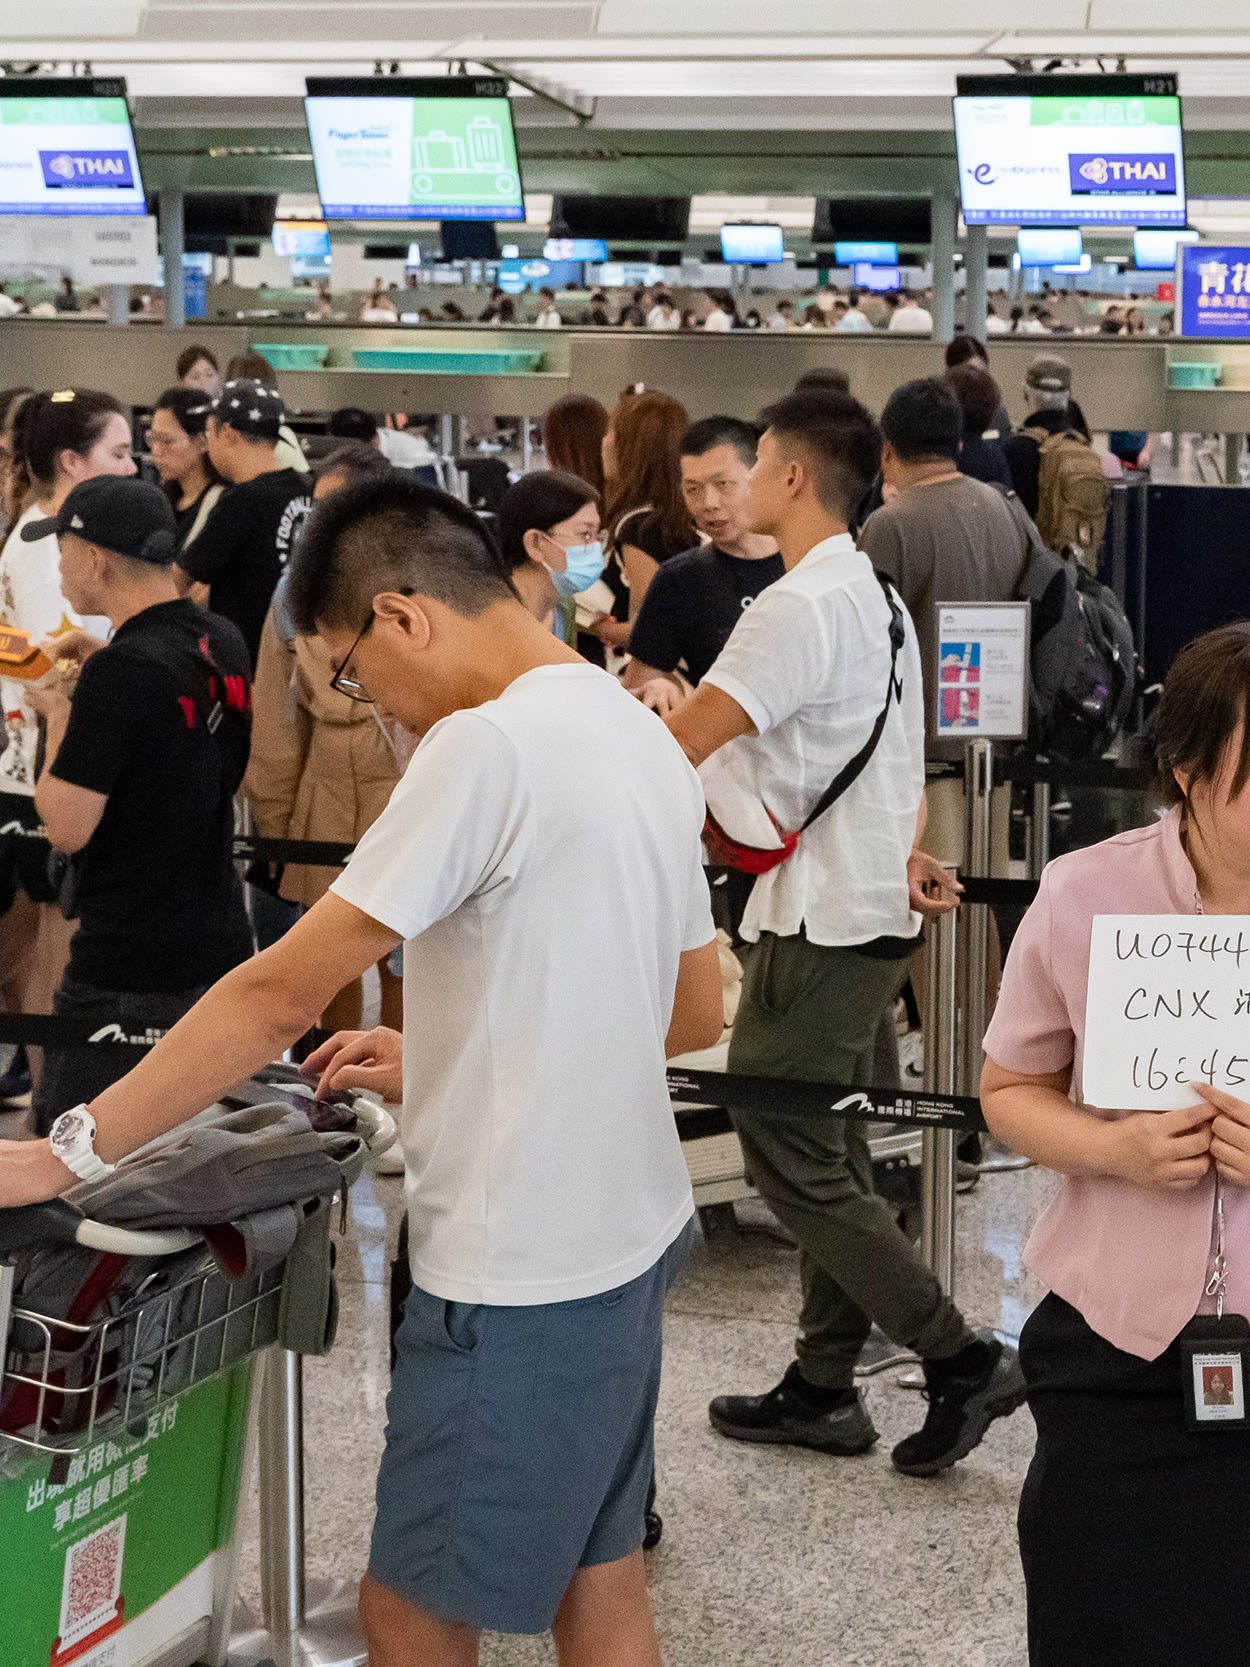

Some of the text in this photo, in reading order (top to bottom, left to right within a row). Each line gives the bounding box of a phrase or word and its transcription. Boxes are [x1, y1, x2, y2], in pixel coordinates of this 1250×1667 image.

[73, 157, 124, 175] THAI
[1108, 161, 1167, 180] THAI
[1124, 987, 1218, 1020] CNX
